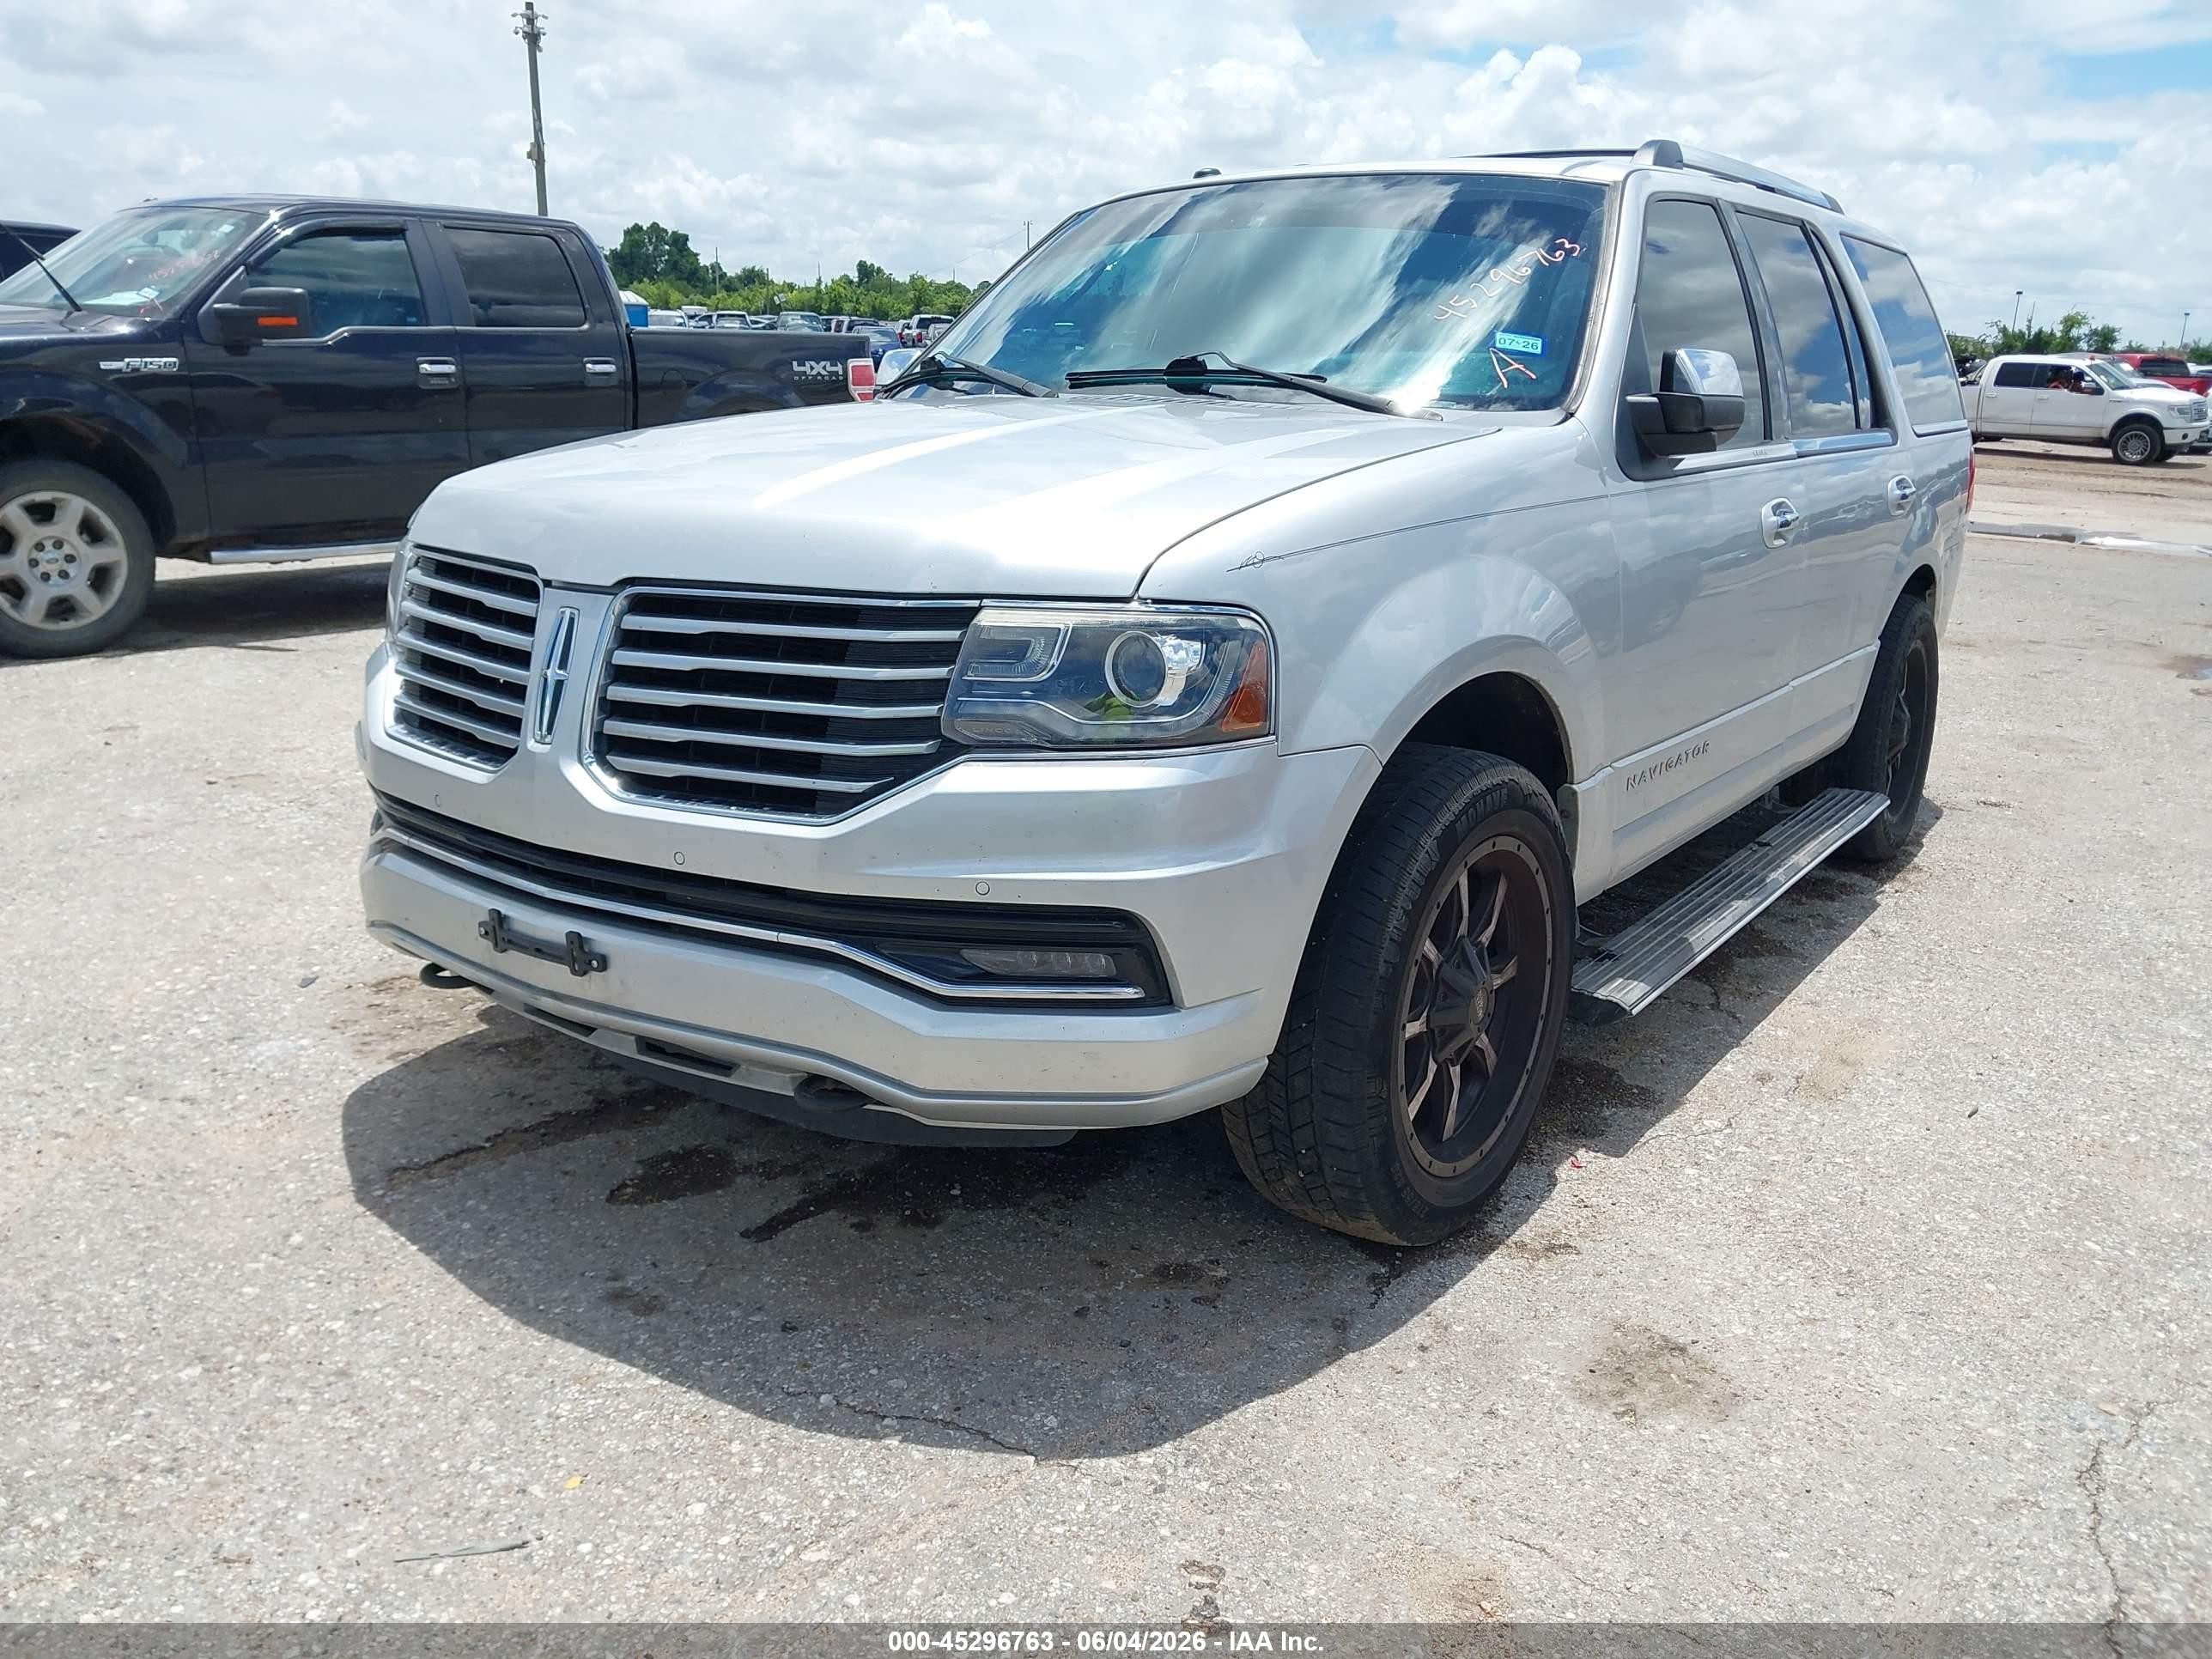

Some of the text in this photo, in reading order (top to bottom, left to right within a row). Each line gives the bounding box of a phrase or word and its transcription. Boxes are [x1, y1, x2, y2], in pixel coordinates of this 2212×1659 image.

[1433, 238, 1582, 320] 45296763
[122, 357, 179, 372] F150
[793, 361, 842, 374] 4X4
[1489, 347, 1538, 389] A
[1626, 740, 1710, 792] NAVIGATOR
